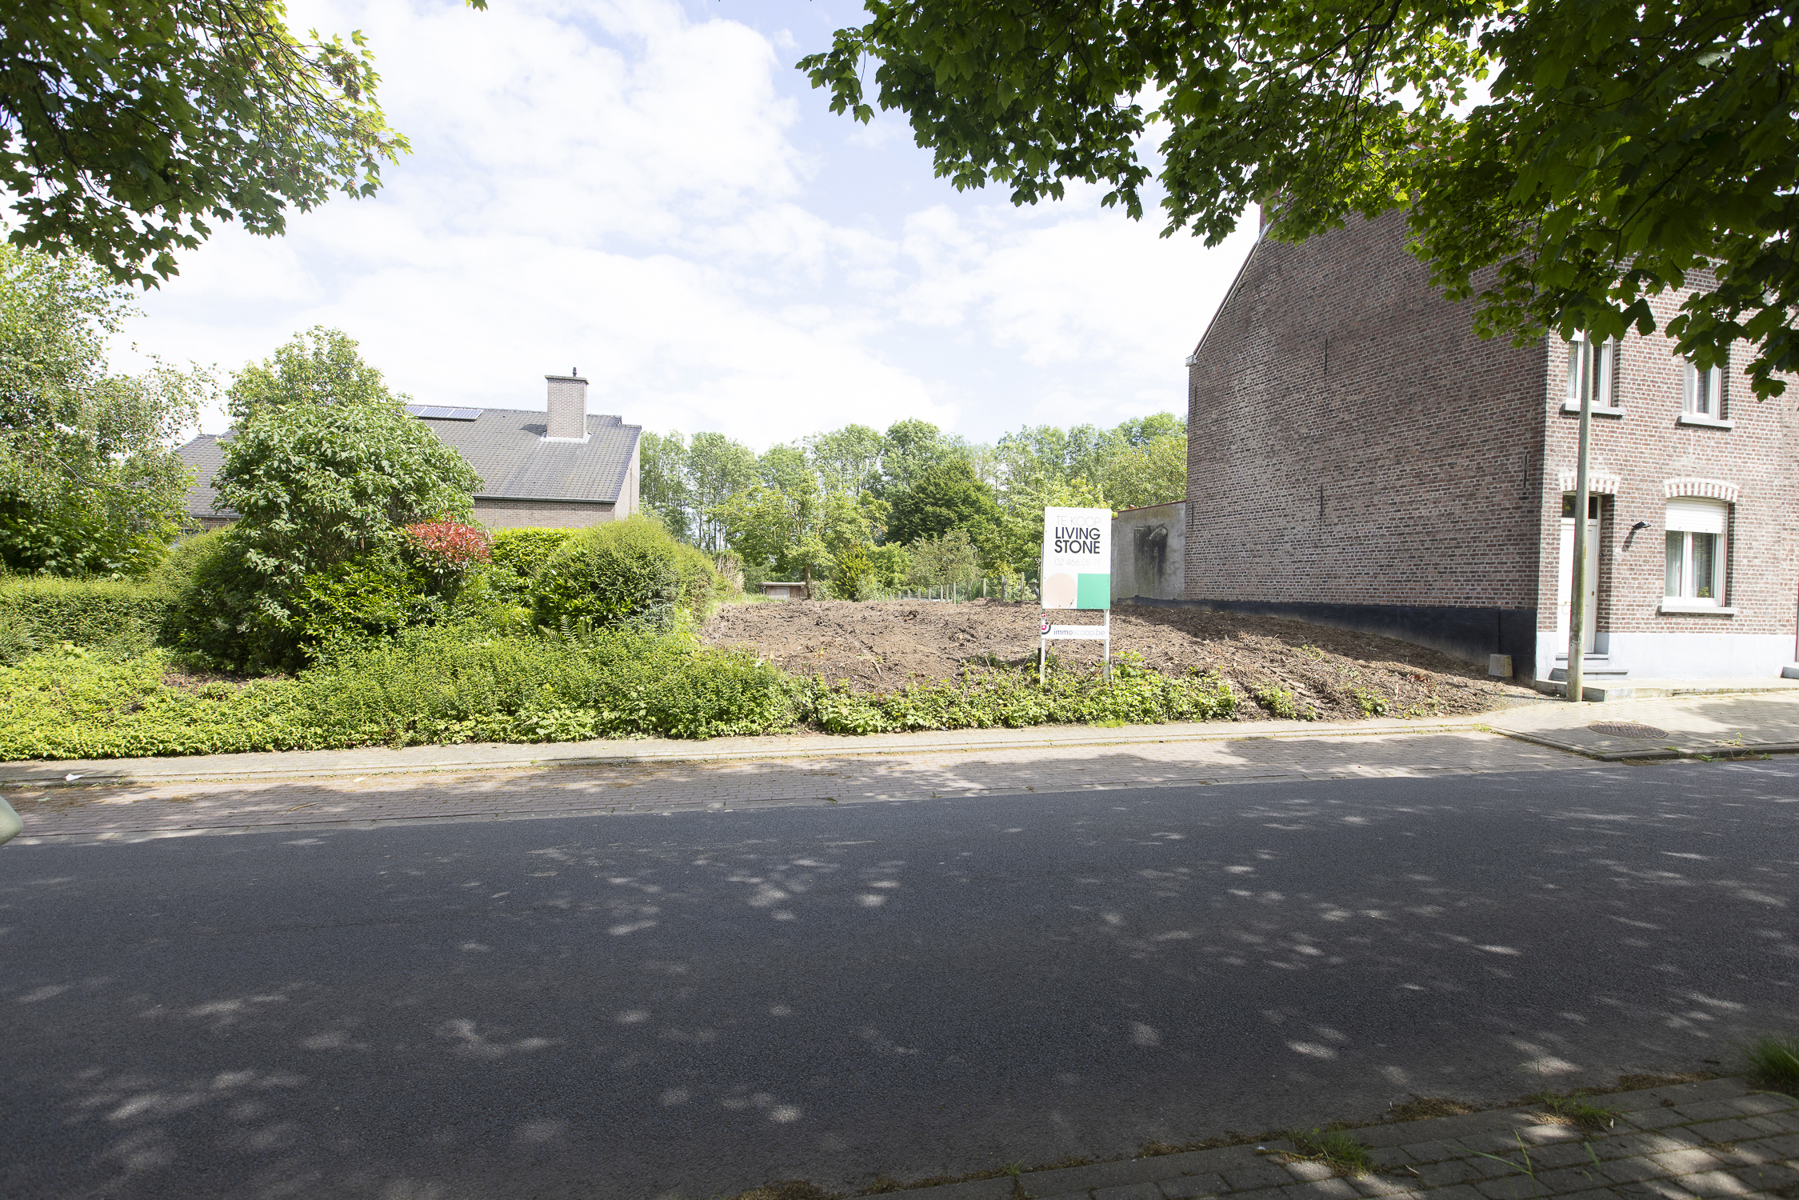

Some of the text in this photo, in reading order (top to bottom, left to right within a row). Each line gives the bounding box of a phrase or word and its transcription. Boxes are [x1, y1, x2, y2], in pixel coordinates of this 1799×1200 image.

[1056, 515, 1101, 527] TE KOOP
[1055, 526, 1101, 540] LIVING
[1054, 539, 1101, 554] STONE
[1054, 558, 1064, 566] 02
[1066, 558, 1080, 566] 466
[1053, 628, 1106, 637] immoscoop.be
